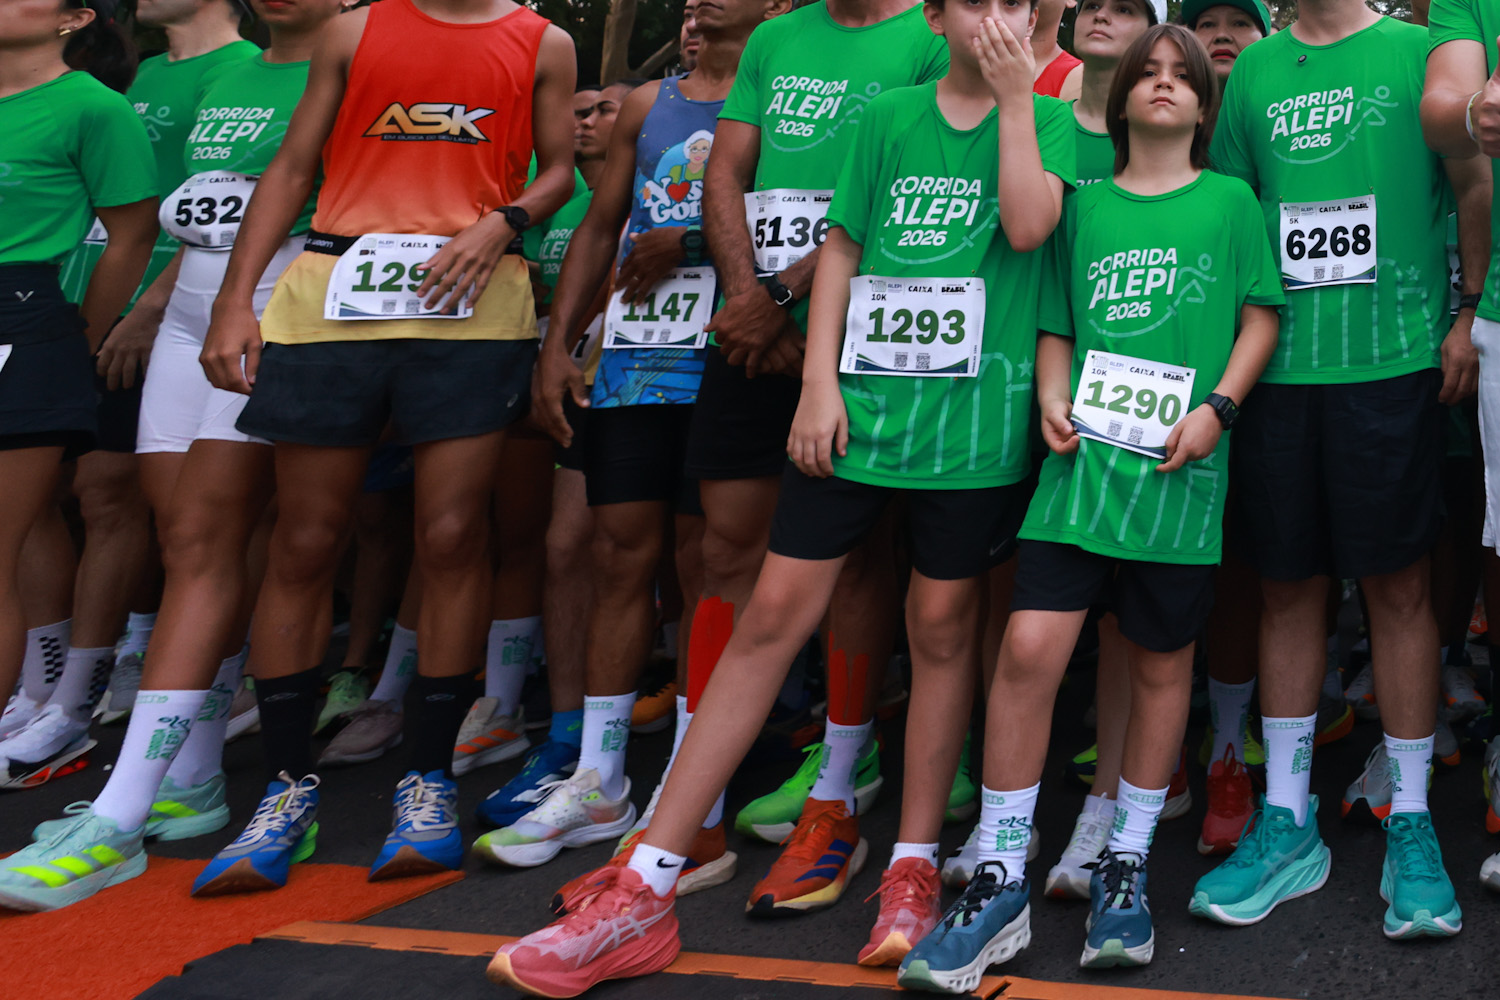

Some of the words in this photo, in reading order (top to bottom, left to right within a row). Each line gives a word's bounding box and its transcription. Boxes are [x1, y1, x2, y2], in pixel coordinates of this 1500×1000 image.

[771, 75, 849, 96] CORRIDA
[197, 107, 275, 122] CORRIDA
[765, 91, 844, 120] ALEPI
[1266, 86, 1354, 119] CORRIDA
[187, 121, 268, 143] ALEPI
[361, 101, 497, 143] ASK
[774, 119, 816, 137] 2026
[1270, 101, 1354, 142] ALEPI
[191, 146, 232, 160] 2026
[1289, 132, 1332, 152] 2026
[889, 175, 983, 198] CORRIDA
[174, 195, 243, 227] 532
[883, 196, 980, 227] ALEPI
[1319, 205, 1342, 213] CAIXA
[754, 216, 829, 250] 5136
[897, 229, 948, 246] 2026
[1286, 223, 1371, 261] 6268
[351, 261, 457, 292] 129
[1087, 247, 1178, 281] CORRIDA
[908, 285, 933, 293] CAIXA
[1088, 267, 1178, 310] ALEPI
[622, 293, 700, 322] 1147
[1105, 300, 1152, 322] 2026
[866, 307, 966, 345] 1293
[1091, 368, 1107, 376] 10K
[1129, 366, 1155, 377] CAIXA
[1083, 380, 1182, 427] 1290
[1290, 746, 1305, 775] CORRIDA
